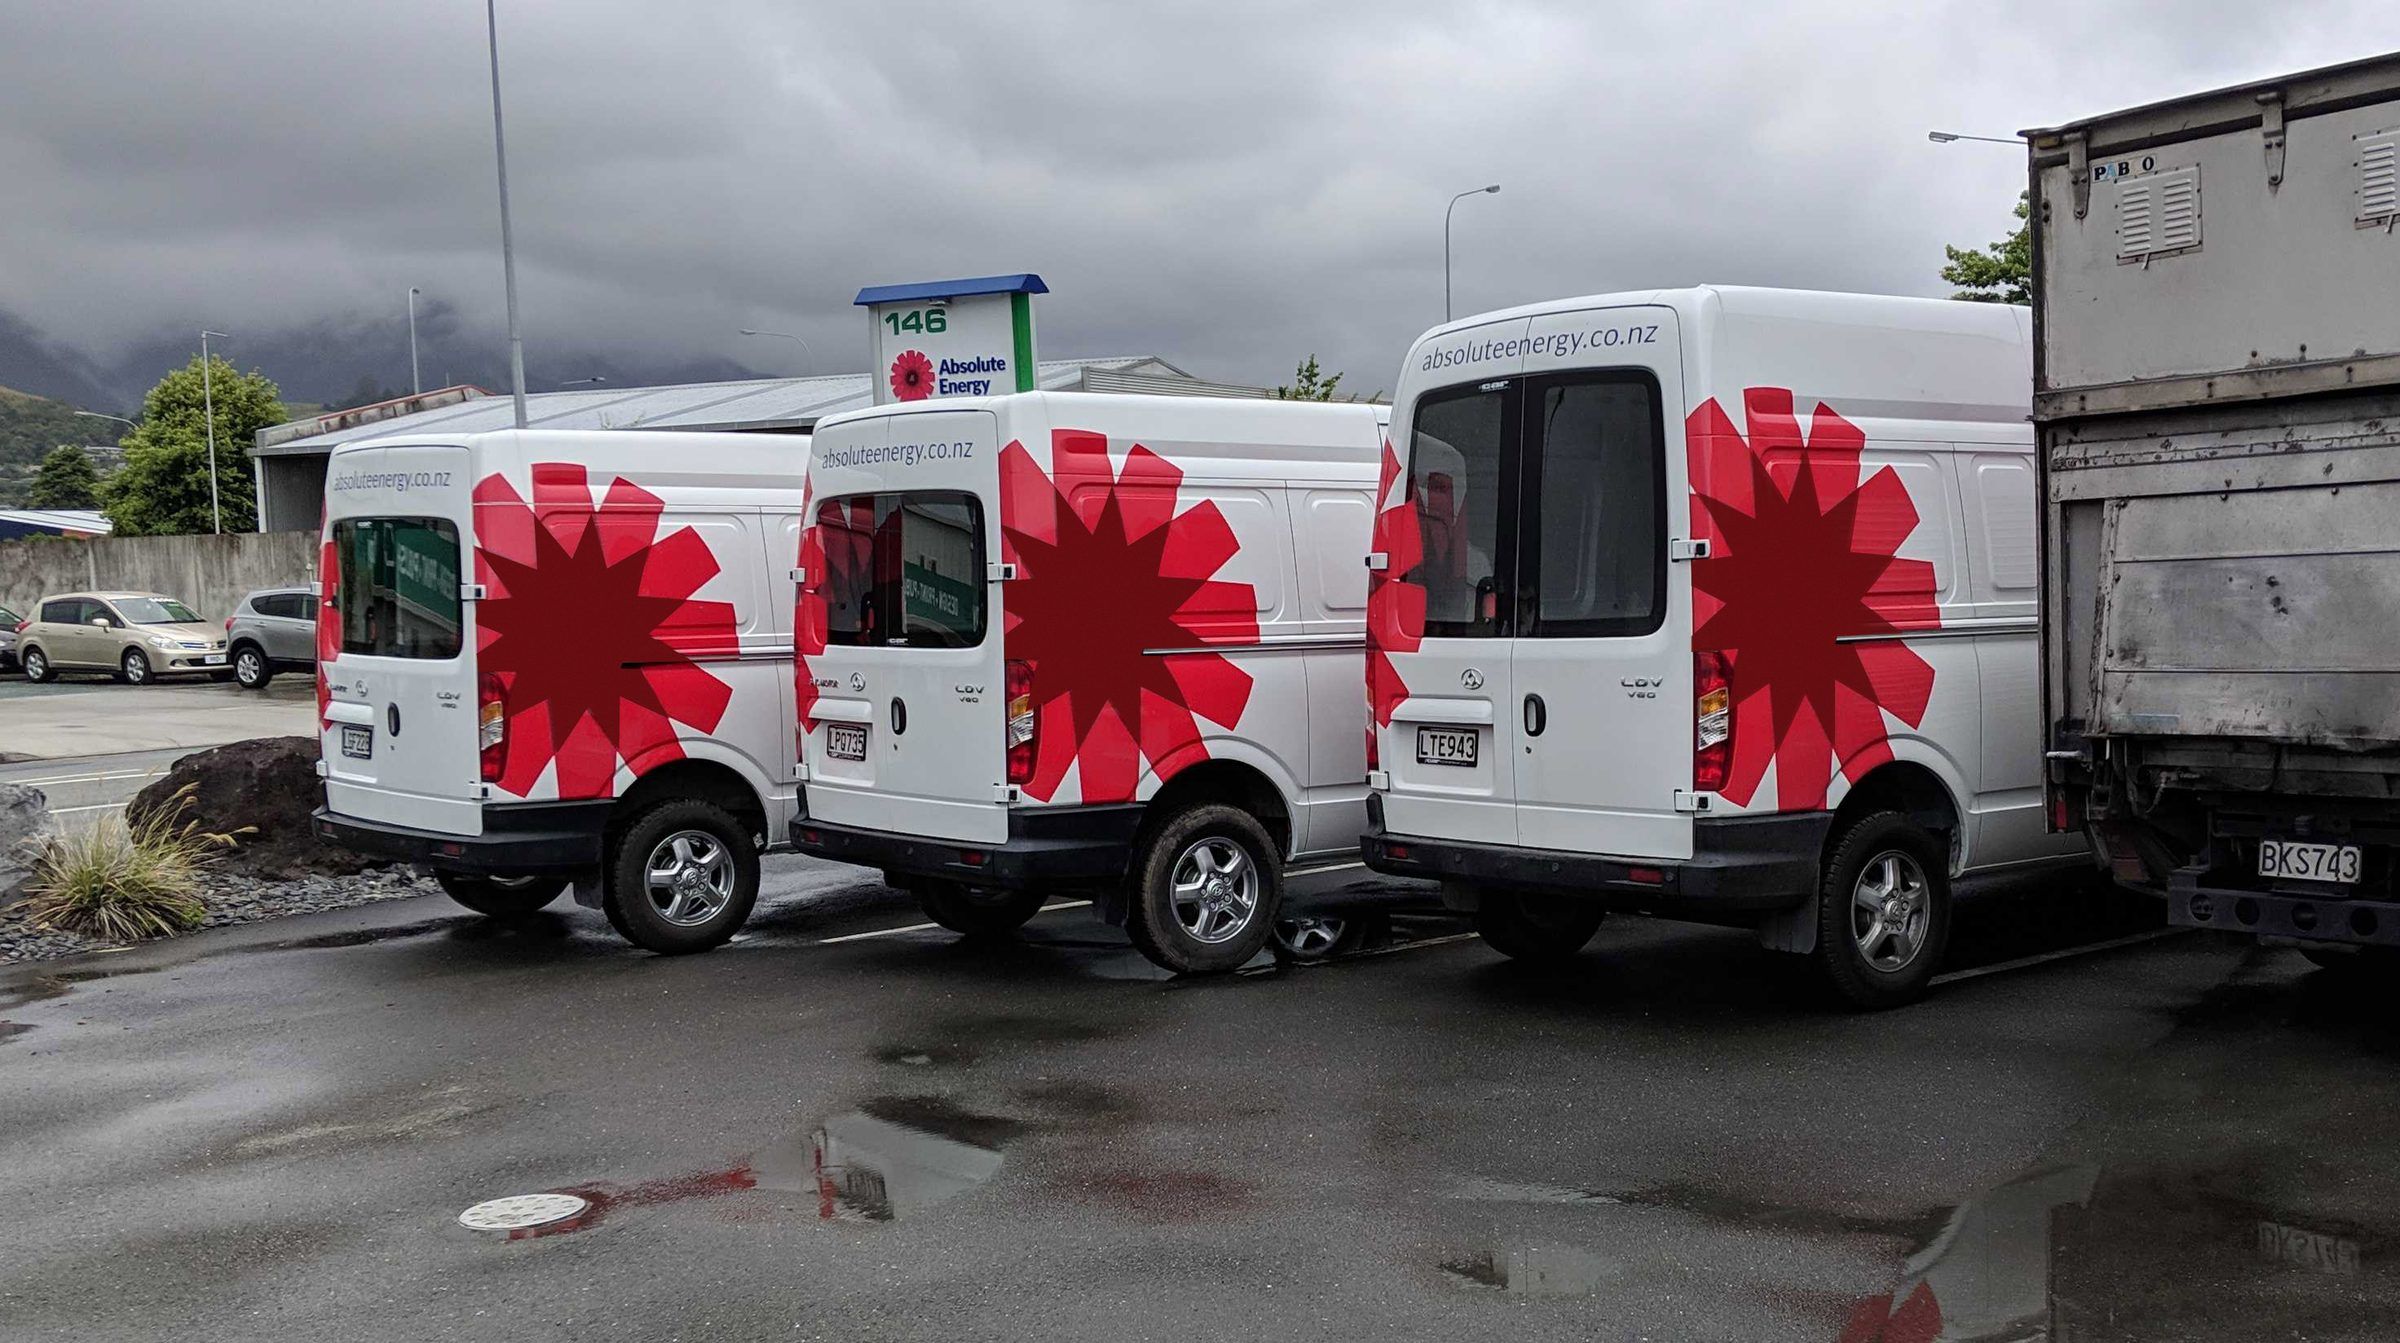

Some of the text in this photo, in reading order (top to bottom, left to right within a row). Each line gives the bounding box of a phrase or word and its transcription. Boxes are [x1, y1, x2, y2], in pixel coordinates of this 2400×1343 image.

[885, 308, 947, 336] 146
[1422, 325, 1659, 372] absoluteenergy.co.nz
[939, 356, 1006, 375] Absolute
[939, 378, 991, 396] Energy
[822, 441, 974, 469] absoluteenergy.co.nz
[334, 470, 452, 492] absoluteenergy.co.nz
[955, 685, 985, 694] LDV
[1620, 677, 1664, 688] LDV
[1420, 733, 1475, 759] LTE943
[2261, 844, 2358, 879] BKS743
